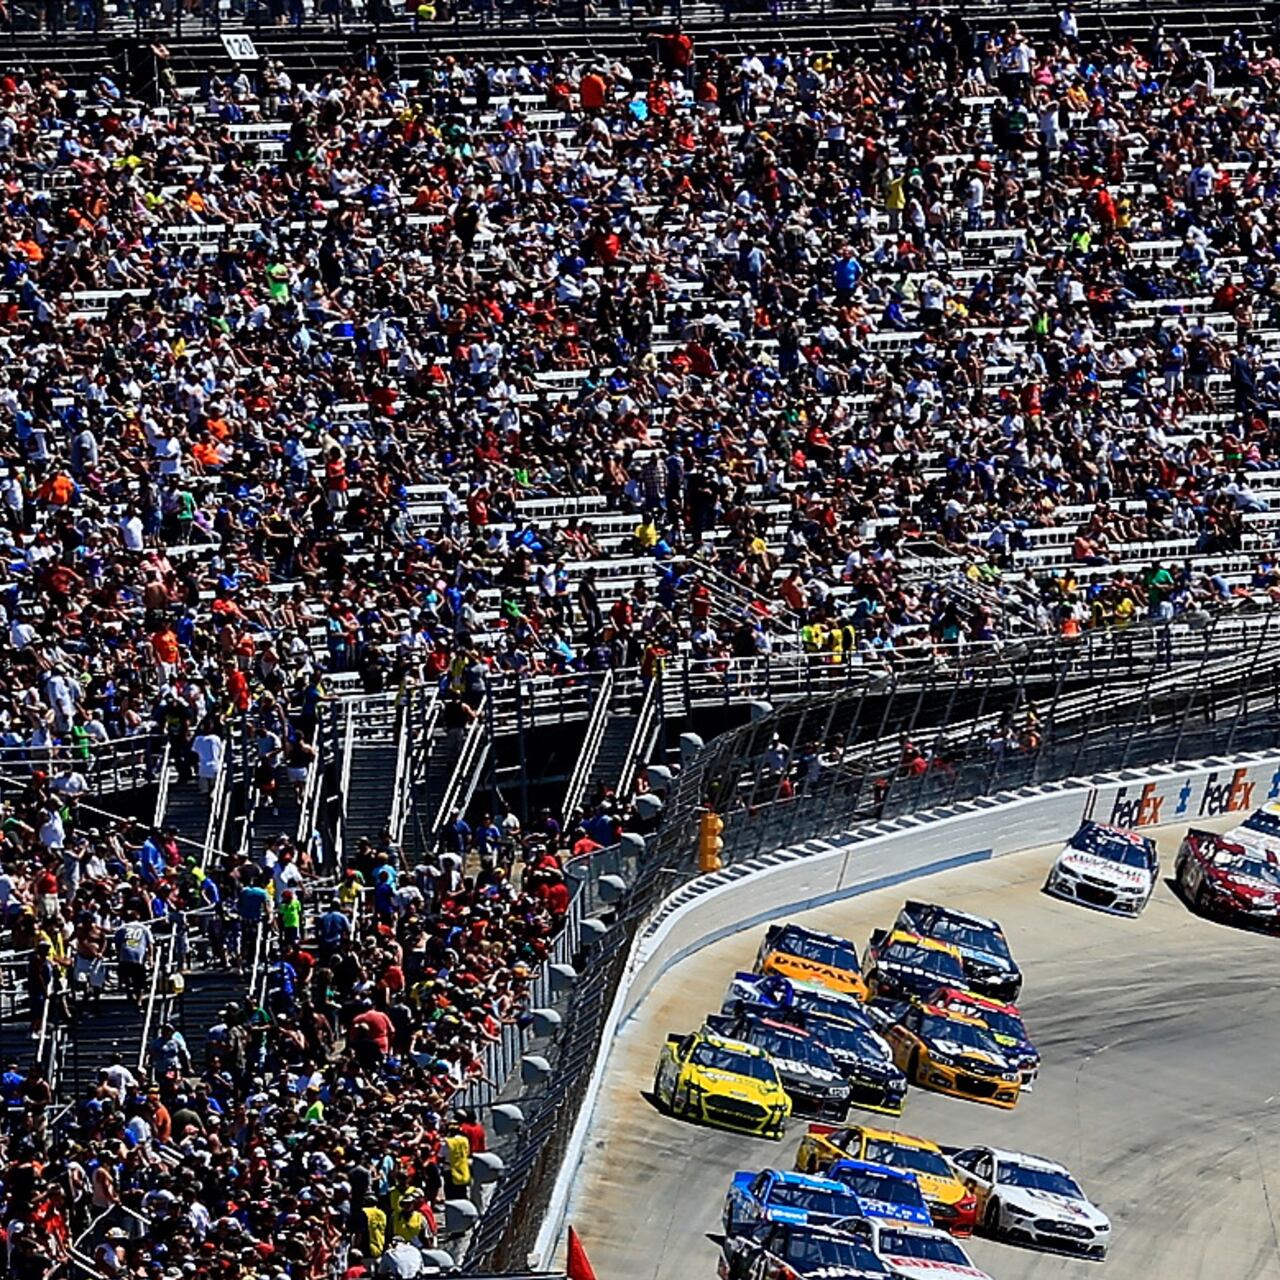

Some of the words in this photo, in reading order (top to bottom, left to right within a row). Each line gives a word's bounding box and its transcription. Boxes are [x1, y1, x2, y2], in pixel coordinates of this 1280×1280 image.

[226, 38, 254, 56] 120
[1110, 783, 1164, 827] FedEx
[1199, 768, 1256, 816] FedEx
